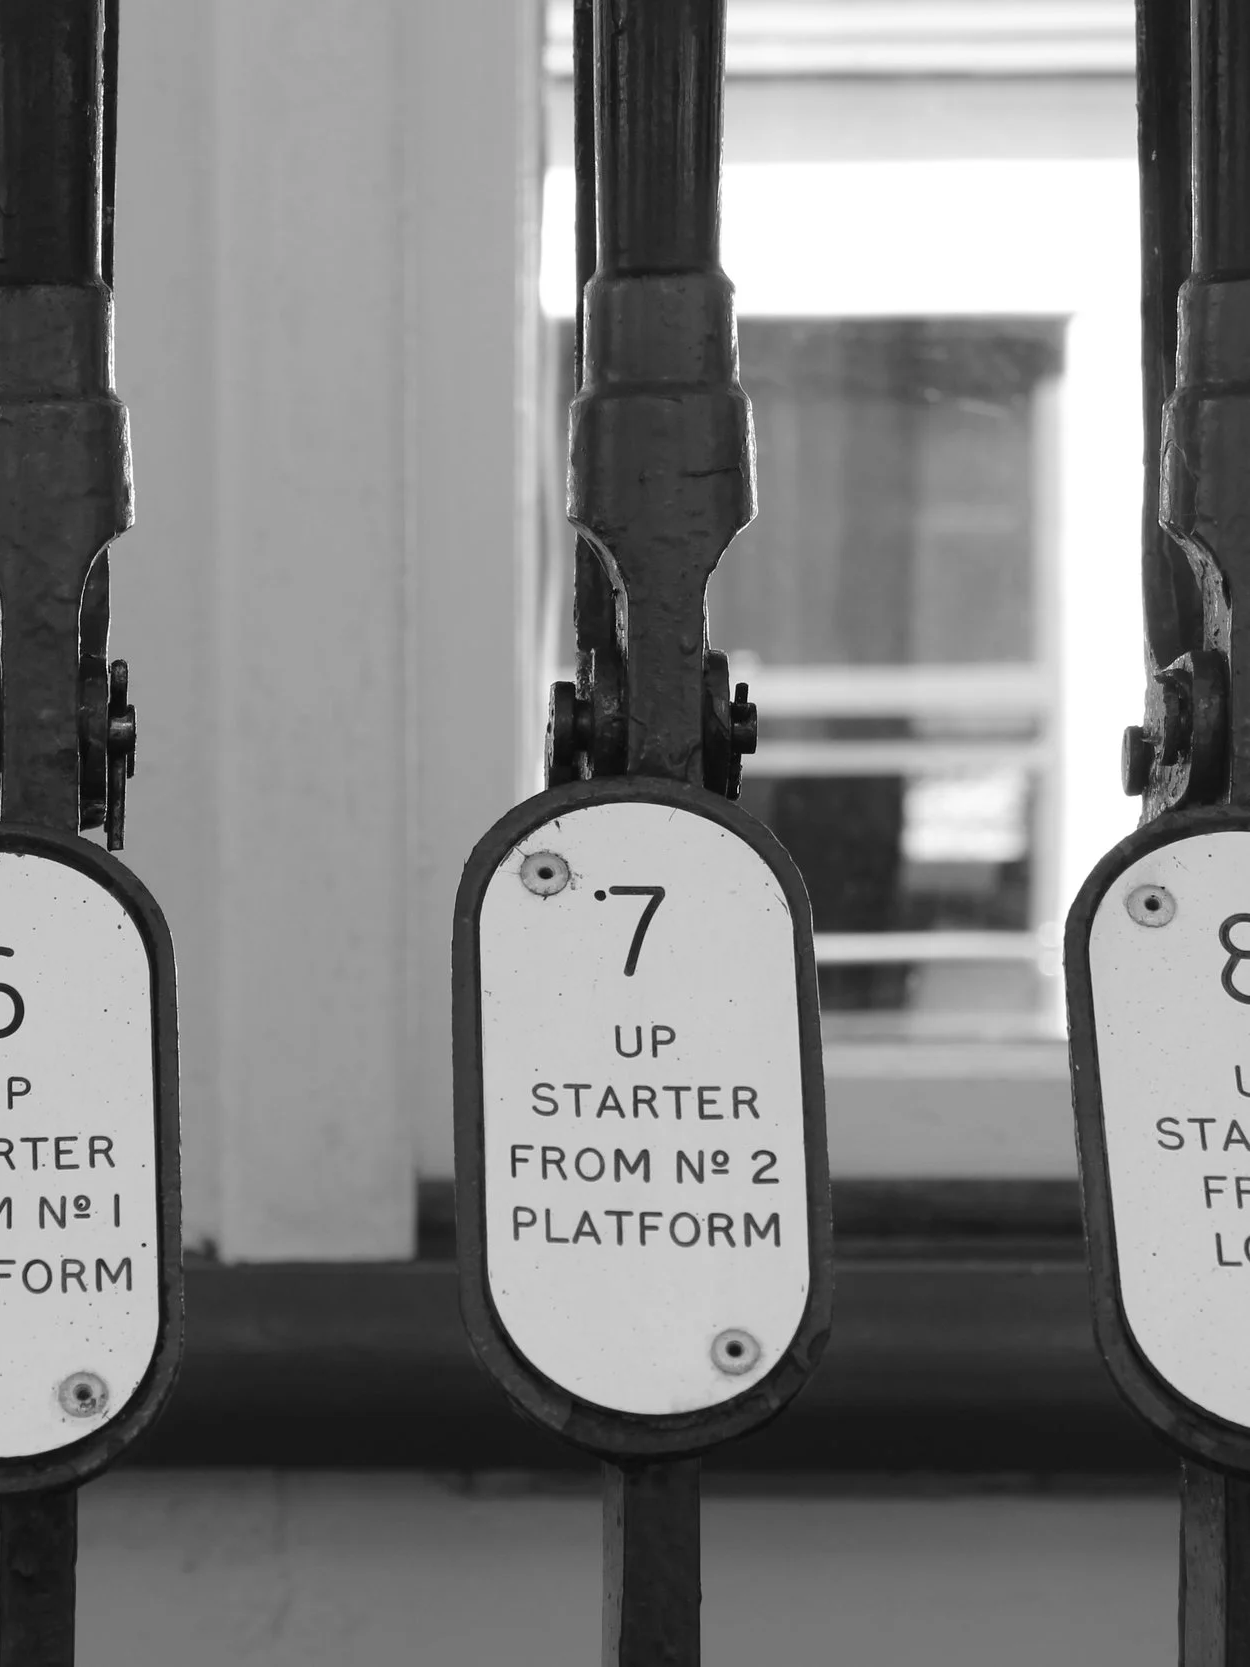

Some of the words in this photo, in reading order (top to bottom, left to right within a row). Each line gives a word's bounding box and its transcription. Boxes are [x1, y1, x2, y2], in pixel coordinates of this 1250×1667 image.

[608, 885, 666, 977] 7
[1218, 912, 1250, 1005] 8
[614, 1024, 676, 1058] UP
[531, 1082, 760, 1121] STARTER
[1156, 1117, 1250, 1152] STA
[510, 1144, 651, 1183] FROM
[751, 1149, 780, 1185] 2
[512, 1206, 781, 1248] PLATFORM
